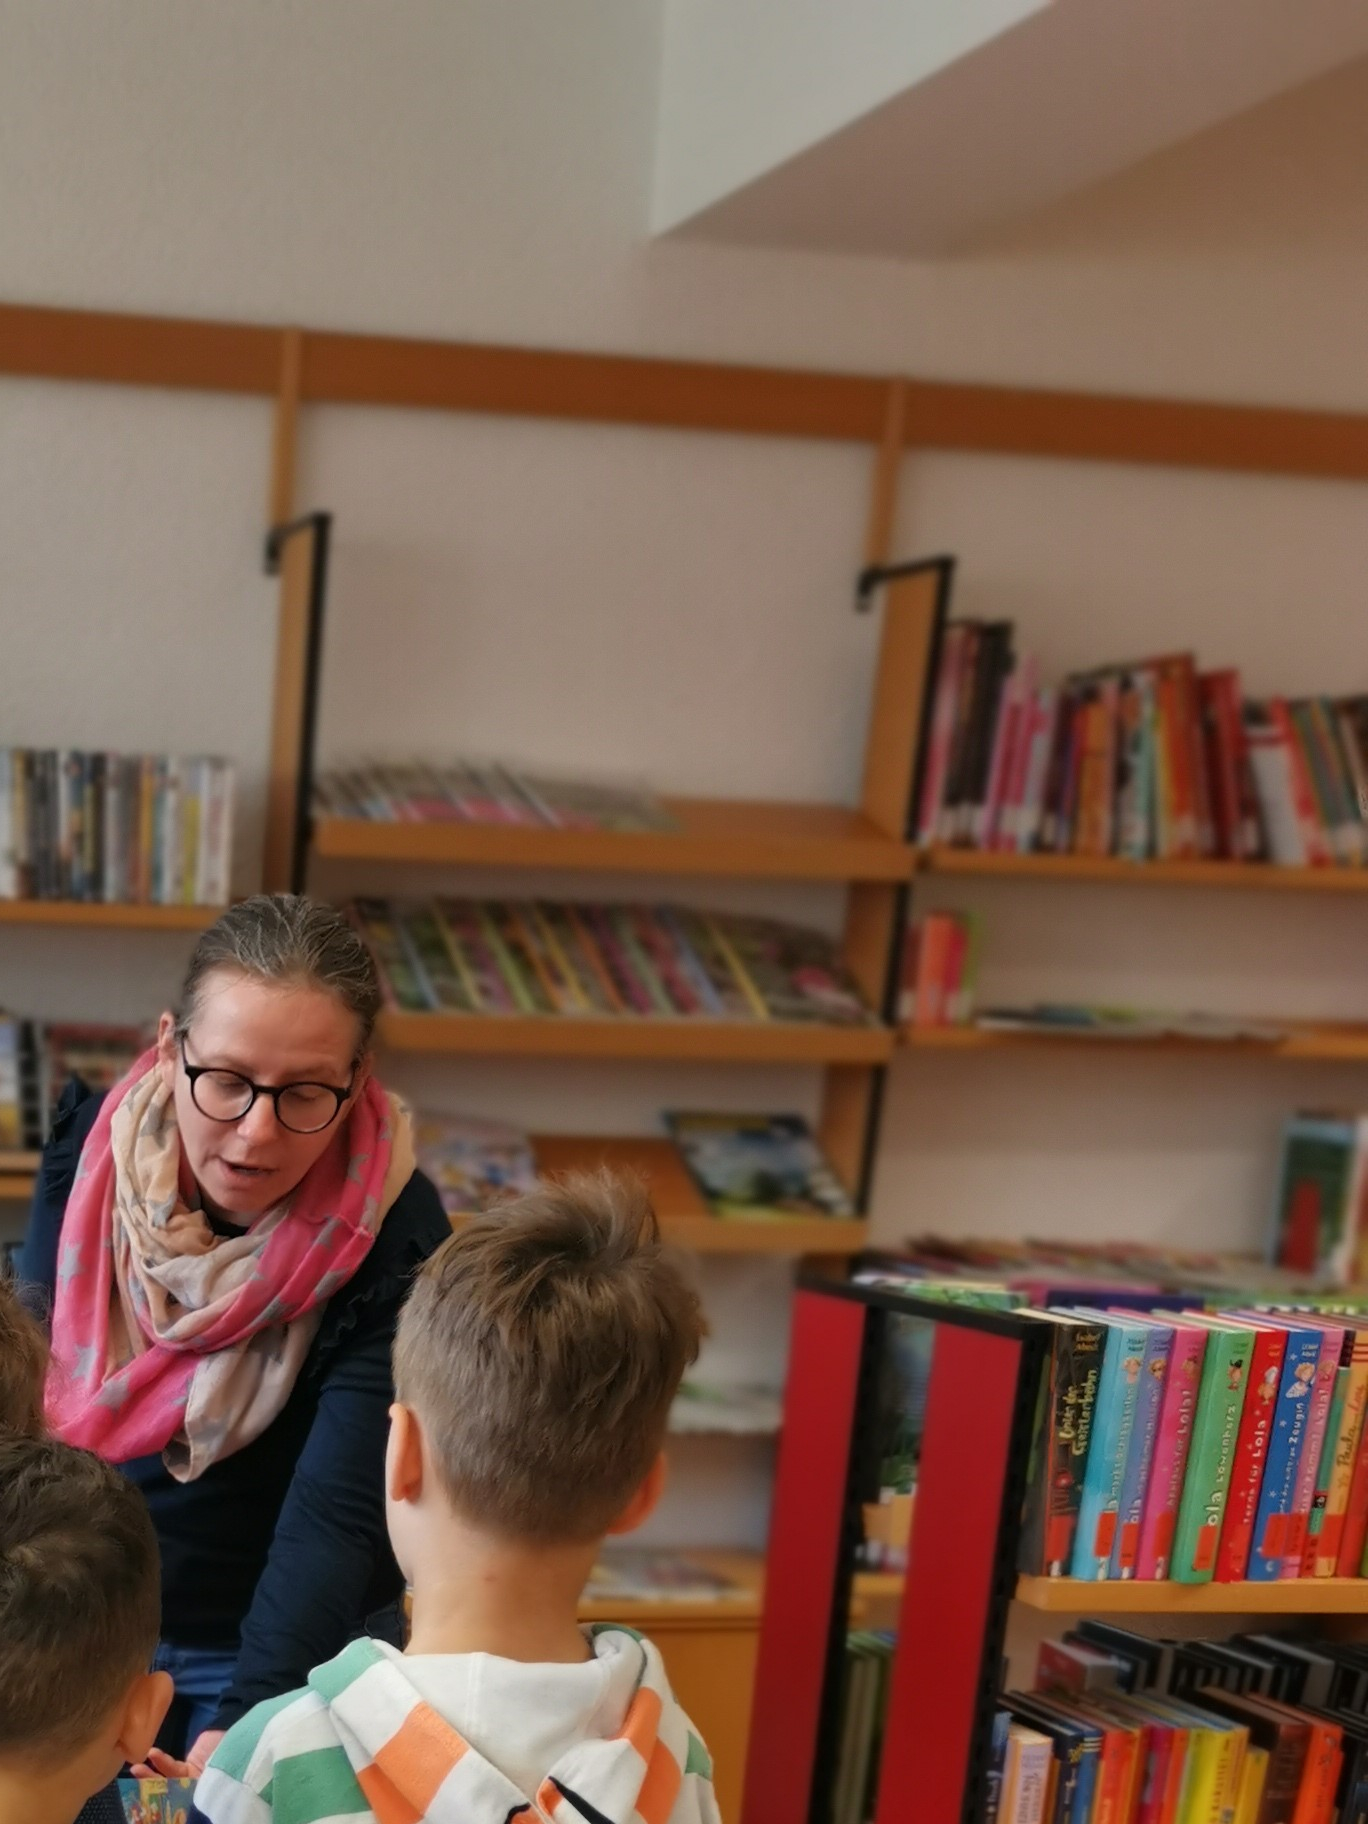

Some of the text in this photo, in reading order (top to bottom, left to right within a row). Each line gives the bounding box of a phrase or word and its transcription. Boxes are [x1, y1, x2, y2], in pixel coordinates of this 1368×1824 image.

[1176, 1390, 1192, 1434] Lola!
[1288, 1402, 1305, 1444] Zeugin
[1314, 1389, 1334, 1426] Lola!
[1251, 1420, 1266, 1458] Lola
[1335, 1426, 1357, 1467] Paula
[1128, 1498, 1143, 1524] ola
[1203, 1489, 1223, 1526] ola
